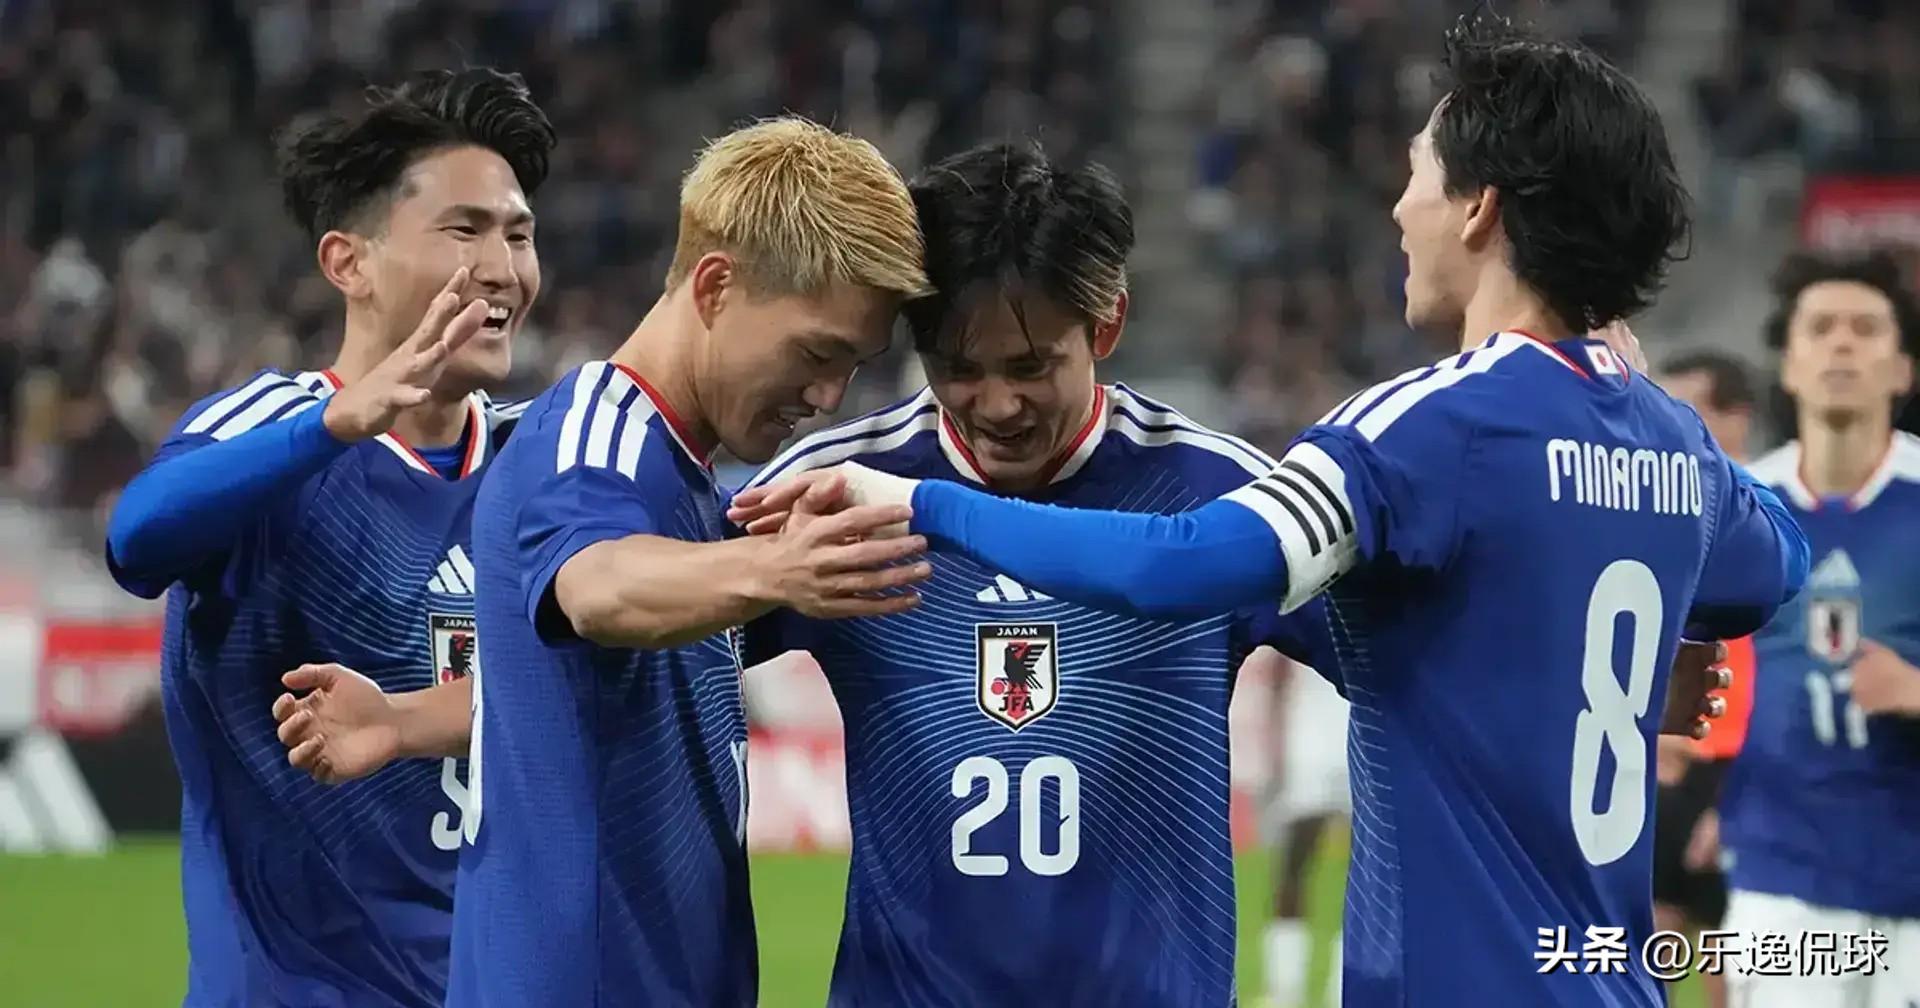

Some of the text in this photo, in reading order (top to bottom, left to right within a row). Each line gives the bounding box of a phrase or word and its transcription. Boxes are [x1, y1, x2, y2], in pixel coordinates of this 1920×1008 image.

[1547, 438, 1702, 517] MINAMINO
[996, 627, 1038, 636] JAPAN
[998, 696, 1035, 712] JFA
[1570, 559, 1663, 866] 8
[951, 756, 1081, 877] 20
